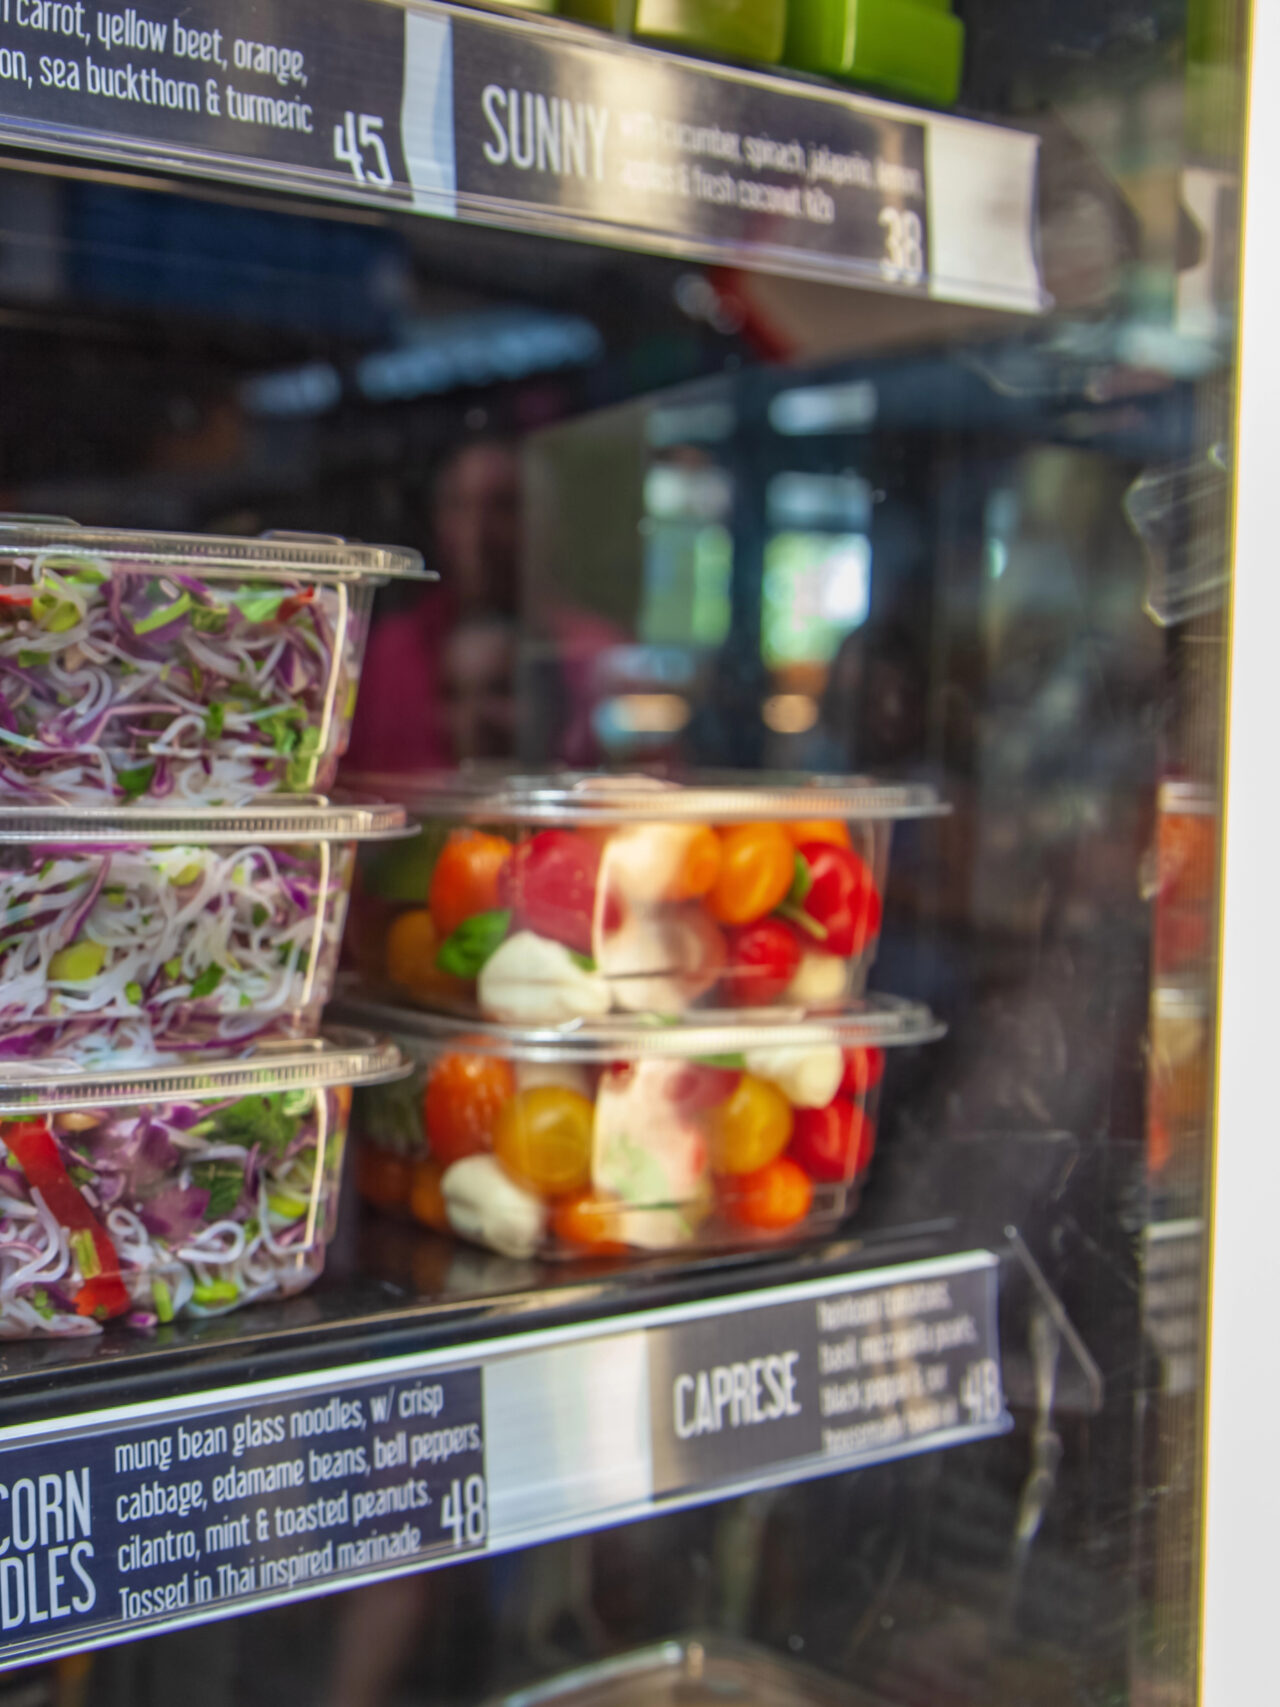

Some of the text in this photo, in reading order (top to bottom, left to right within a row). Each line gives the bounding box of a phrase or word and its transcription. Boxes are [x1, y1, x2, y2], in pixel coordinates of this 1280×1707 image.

[16, 0, 91, 46] carrot,
[97, 8, 167, 53] yellow
[173, 18, 228, 71] beet,
[234, 38, 308, 87] orange,
[40, 56, 81, 91] sea
[86, 56, 200, 112] buckthorn
[206, 78, 221, 116] &
[226, 84, 314, 134] turmeric
[481, 84, 608, 181] SUNNY
[334, 110, 394, 188] 45
[879, 206, 922, 286] 38
[115, 1380, 444, 1474] mung bean glass noodles, w/ crisp
[673, 1350, 802, 1439] CAPRESE
[116, 1423, 483, 1523] cabbage, edamame beans, bell peppers,
[440, 1474, 487, 1549] 48
[118, 1478, 433, 1572] cilantro, mint & toasted peanuts.
[118, 1522, 422, 1620] Tossed in Thai inspired marinade
